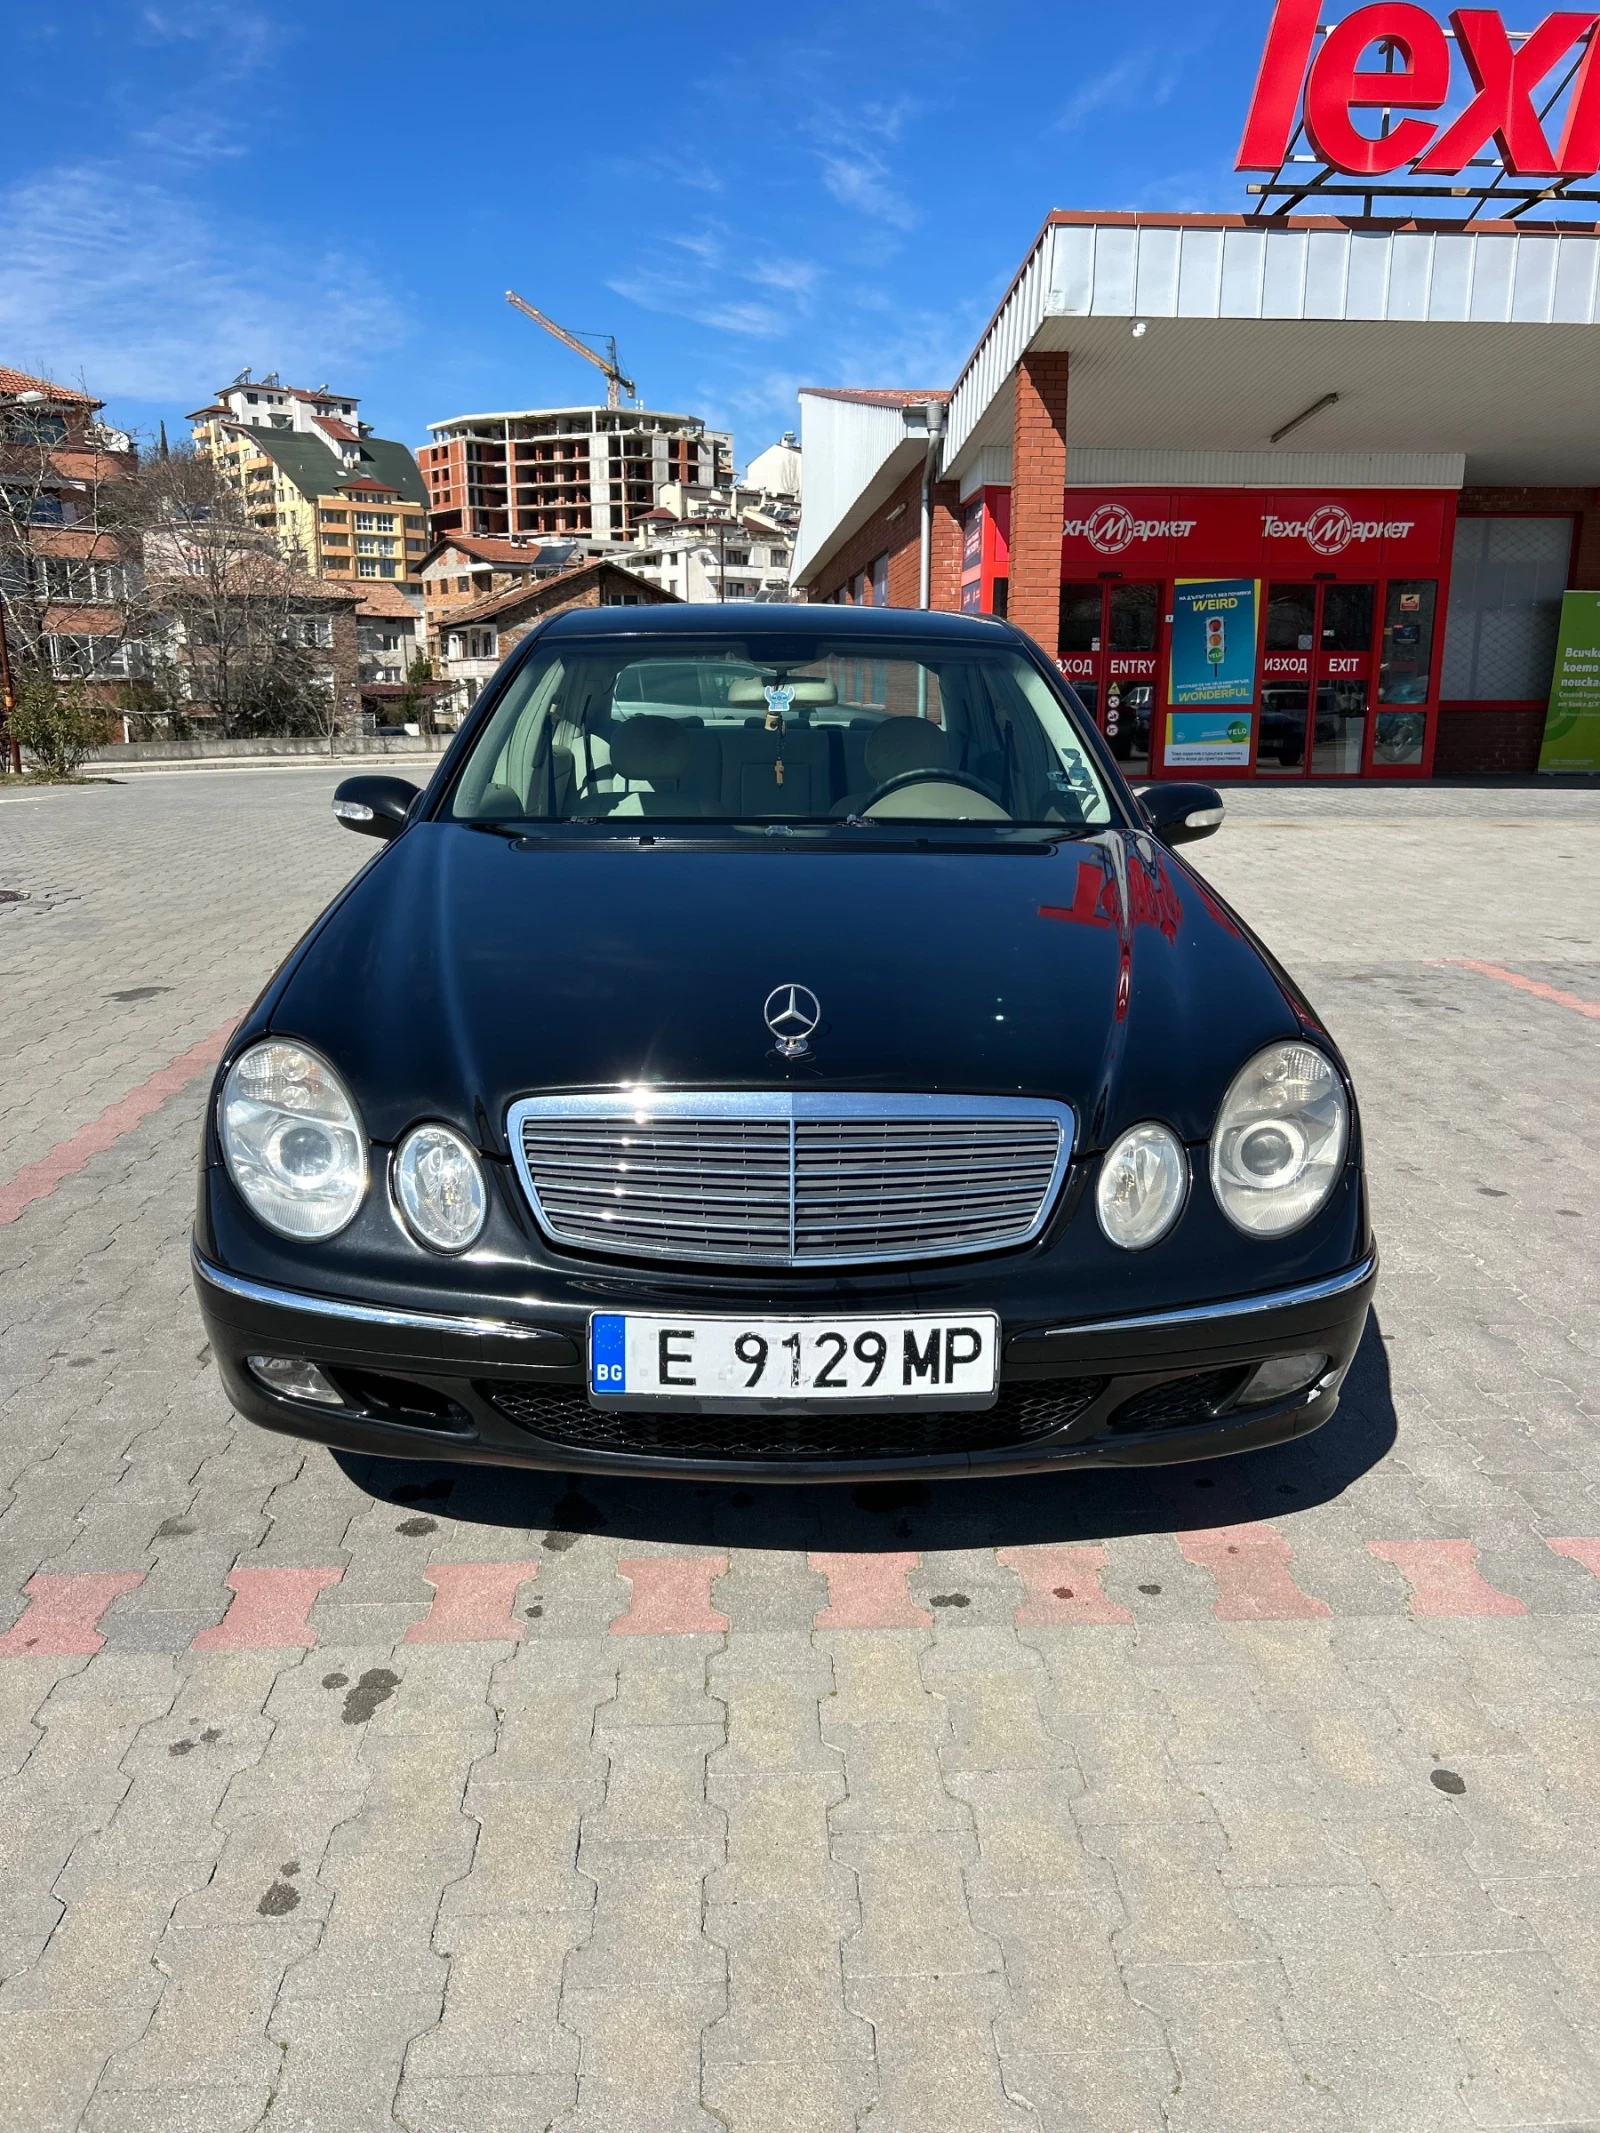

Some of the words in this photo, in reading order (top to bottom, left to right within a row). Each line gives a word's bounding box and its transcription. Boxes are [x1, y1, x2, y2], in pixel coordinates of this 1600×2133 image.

[1193, 598, 1238, 612] WEIRD
[1565, 648, 1600, 658] Всичк
[1110, 660, 1156, 674] ENTRY
[1264, 658, 1308, 673] ИЗХОД
[1328, 658, 1360, 672] EXIT
[1178, 687, 1250, 702] WONDERFUL
[1227, 728, 1248, 736] VELO
[658, 1328, 697, 1386] E
[734, 1330, 888, 1388] 9129
[902, 1327, 982, 1386] MP
[597, 1364, 623, 1381] BG
